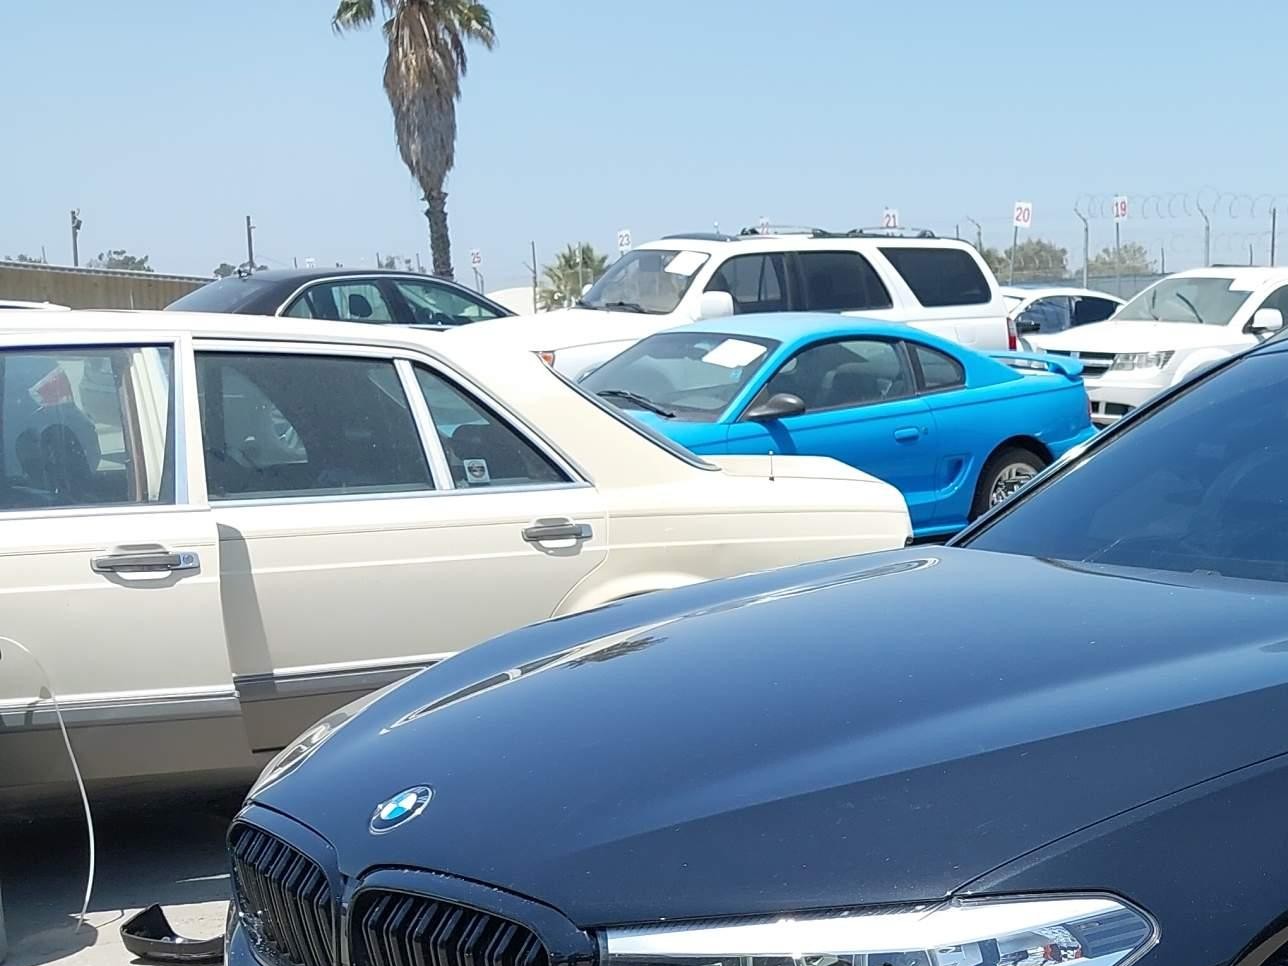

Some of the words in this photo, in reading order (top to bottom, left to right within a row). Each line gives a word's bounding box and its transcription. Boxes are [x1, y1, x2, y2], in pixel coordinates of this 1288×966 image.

[1015, 206, 1031, 223] 20
[1114, 200, 1127, 218] 19
[884, 213, 897, 229] 21
[618, 233, 631, 247] 23
